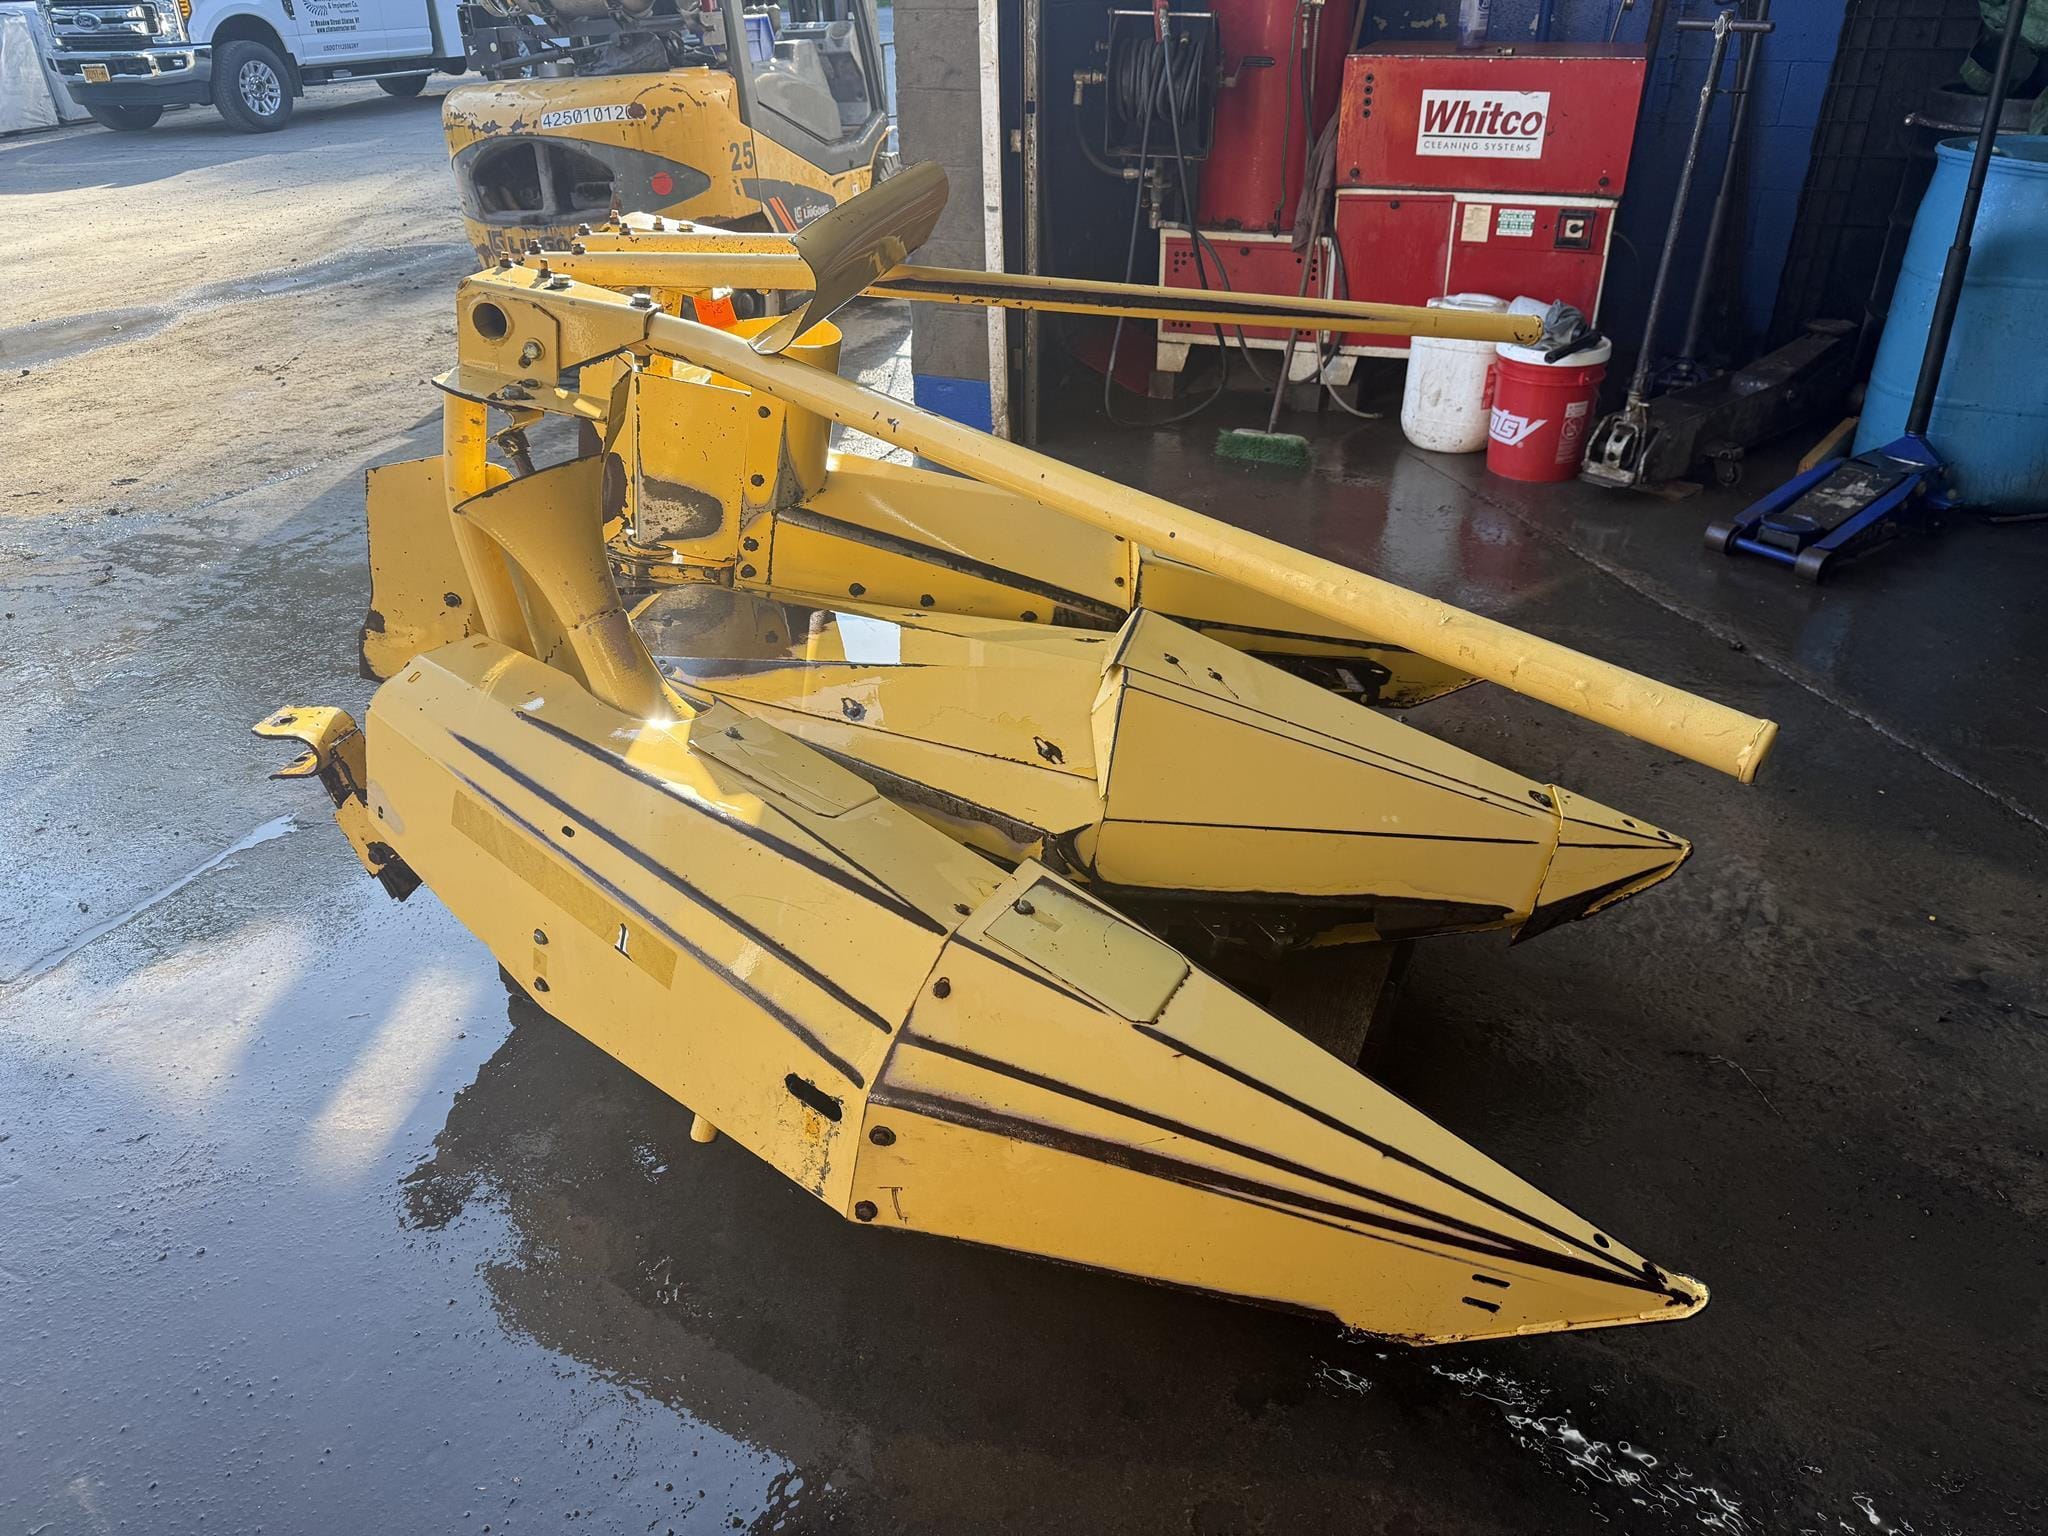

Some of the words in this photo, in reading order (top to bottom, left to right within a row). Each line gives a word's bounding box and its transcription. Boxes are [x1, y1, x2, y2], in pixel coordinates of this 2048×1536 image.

[1423, 99, 1543, 136] Whitco
[730, 141, 754, 171] 25
[1423, 140, 1479, 152] CLEANING
[1484, 142, 1531, 152] SYSTEMS
